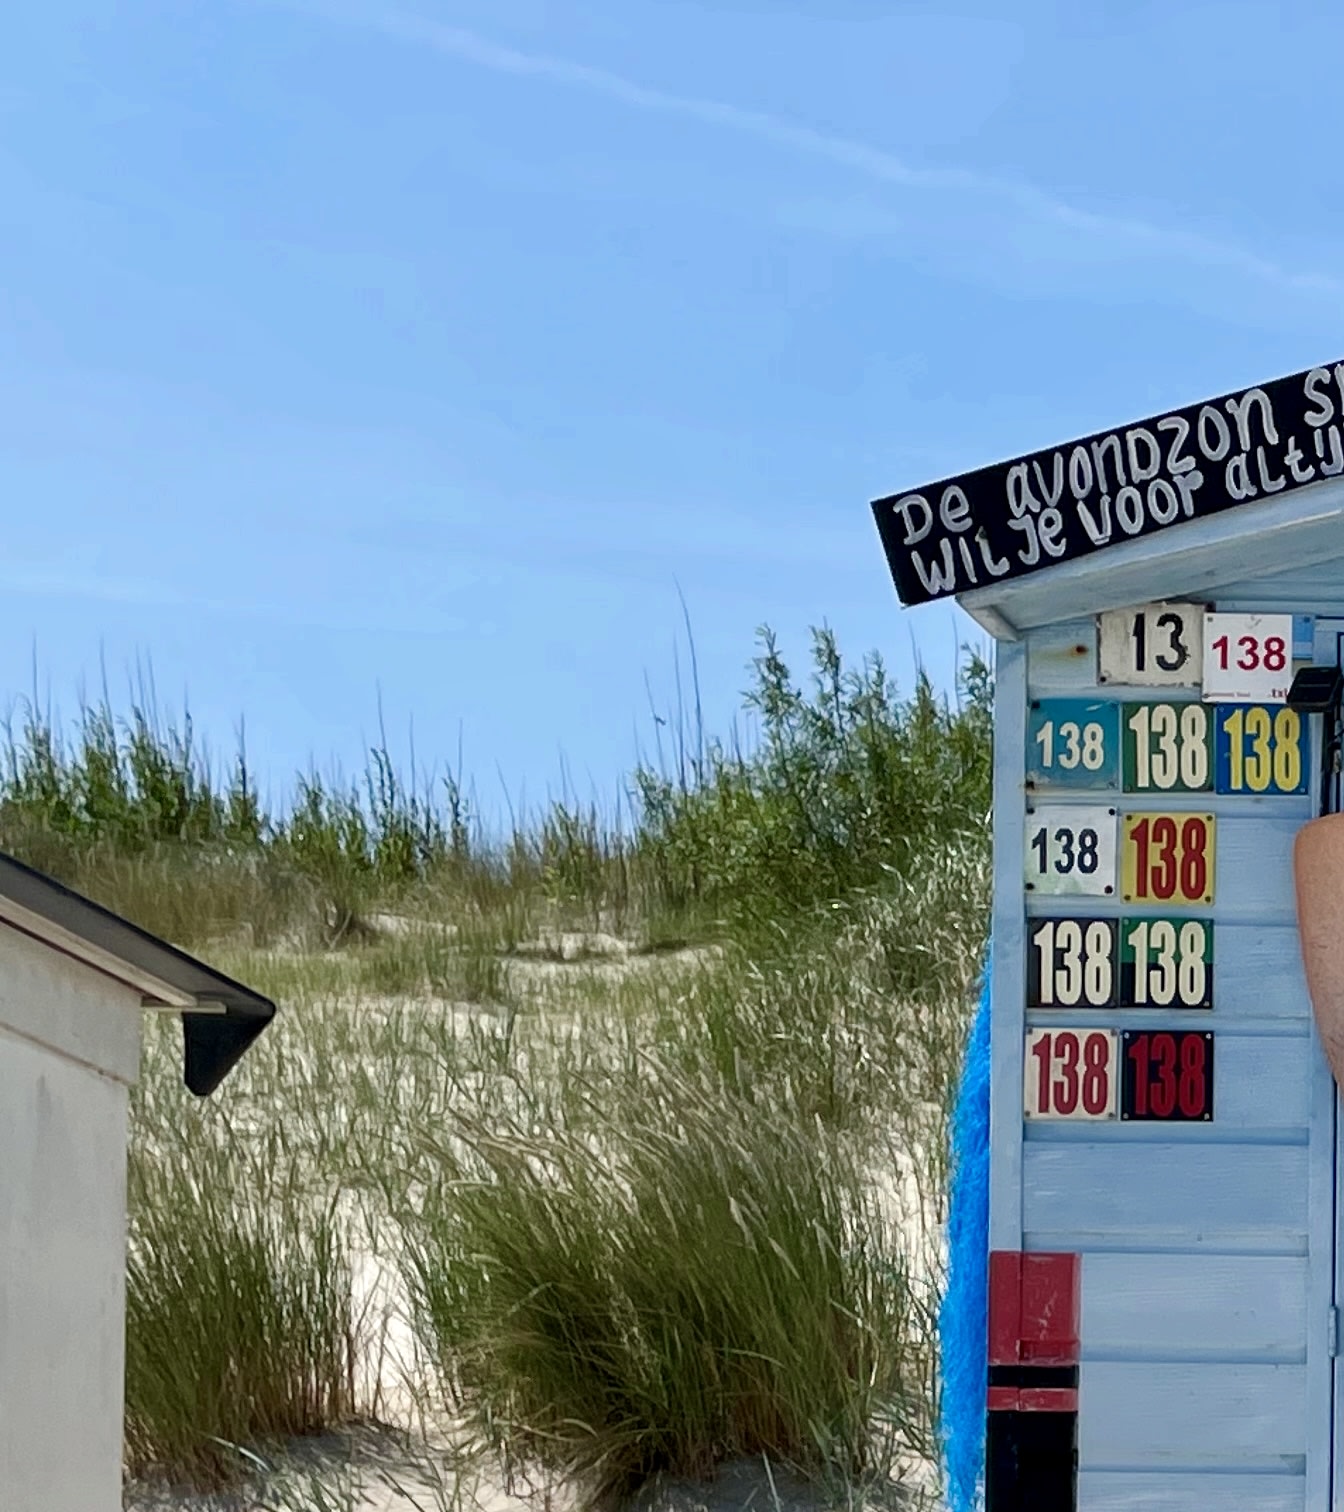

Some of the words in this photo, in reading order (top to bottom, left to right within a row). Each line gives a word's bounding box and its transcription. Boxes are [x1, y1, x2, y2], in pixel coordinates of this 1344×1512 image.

[893, 485, 973, 544] De
[1077, 469, 1204, 546] voor
[1132, 612, 1190, 672] 13
[1212, 636, 1286, 672] 138
[1036, 721, 1104, 770] 138
[1129, 704, 1207, 789] 138
[1223, 707, 1301, 792] 138
[1031, 827, 1099, 874] 138
[1130, 817, 1207, 900] 138
[1033, 921, 1112, 1005] 138
[1128, 921, 1206, 1005] 138
[1032, 1032, 1110, 1115] 138
[1129, 1034, 1205, 1117] 138
